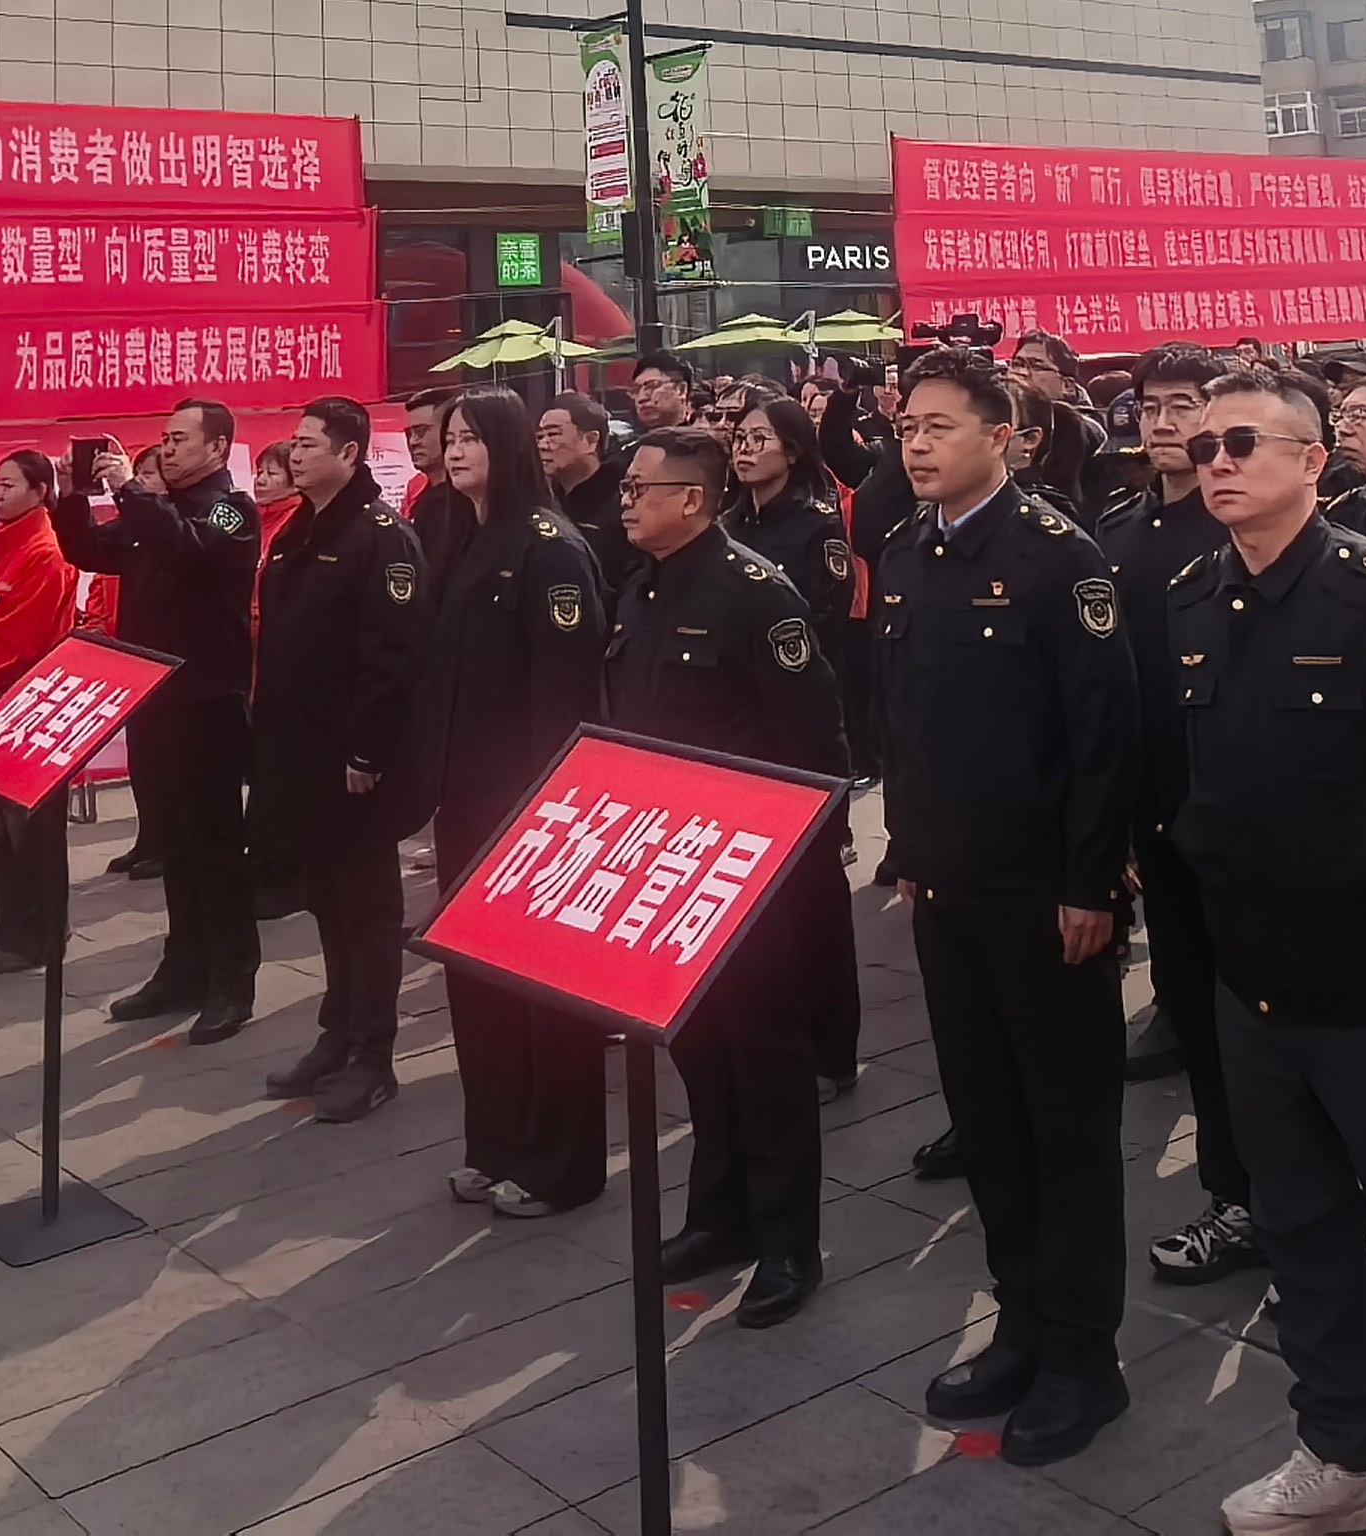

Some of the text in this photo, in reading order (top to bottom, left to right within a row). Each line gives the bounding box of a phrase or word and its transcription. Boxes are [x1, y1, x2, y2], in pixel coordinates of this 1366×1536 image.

[807, 245, 890, 270] PARIS
[484, 786, 773, 965] 市场监管局
